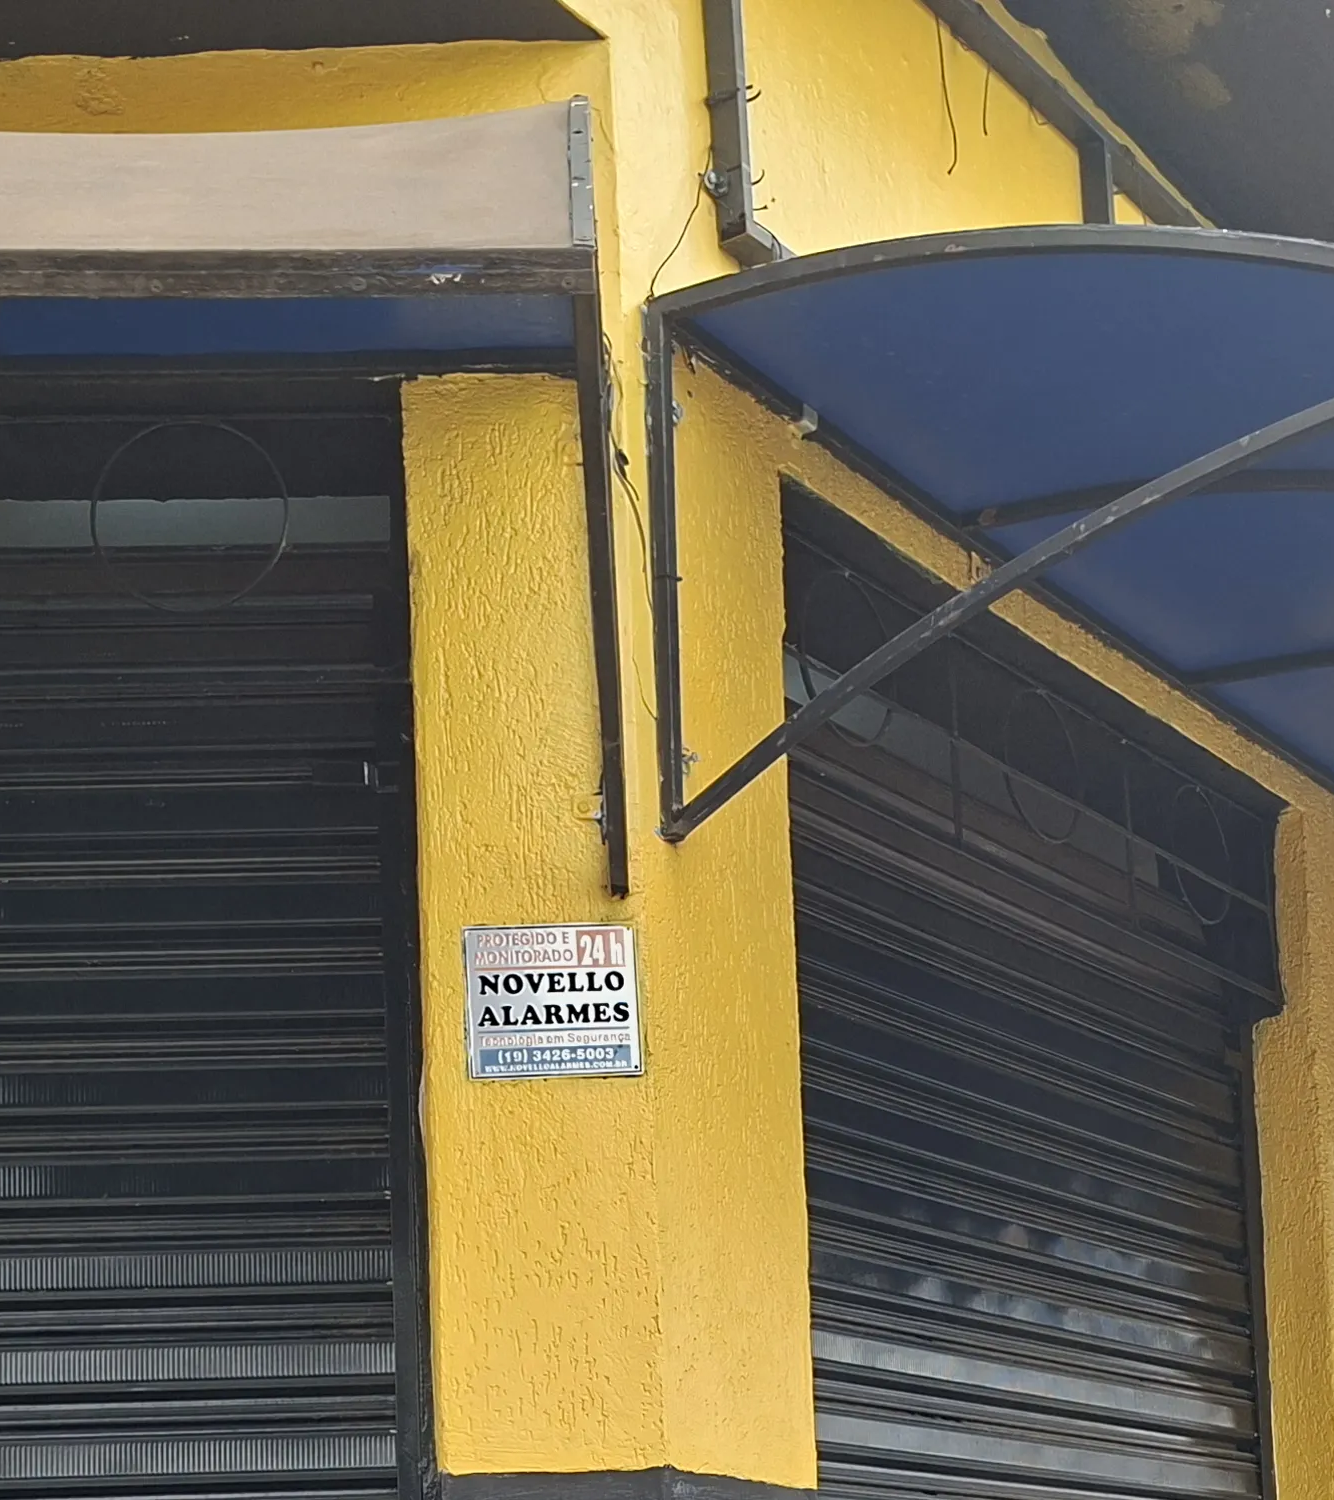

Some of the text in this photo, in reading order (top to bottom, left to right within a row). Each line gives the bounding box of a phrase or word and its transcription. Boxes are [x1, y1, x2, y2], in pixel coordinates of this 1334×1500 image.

[477, 931, 570, 948] PROTEGIDO E
[580, 931, 624, 966] 24 h
[475, 949, 574, 966] MONITORADO
[478, 970, 625, 995] NOVELLO
[478, 1002, 630, 1027] ALARMES
[479, 1032, 631, 1047] Tecnologia em Segurança
[497, 1047, 615, 1064] (19) 3426-5003
